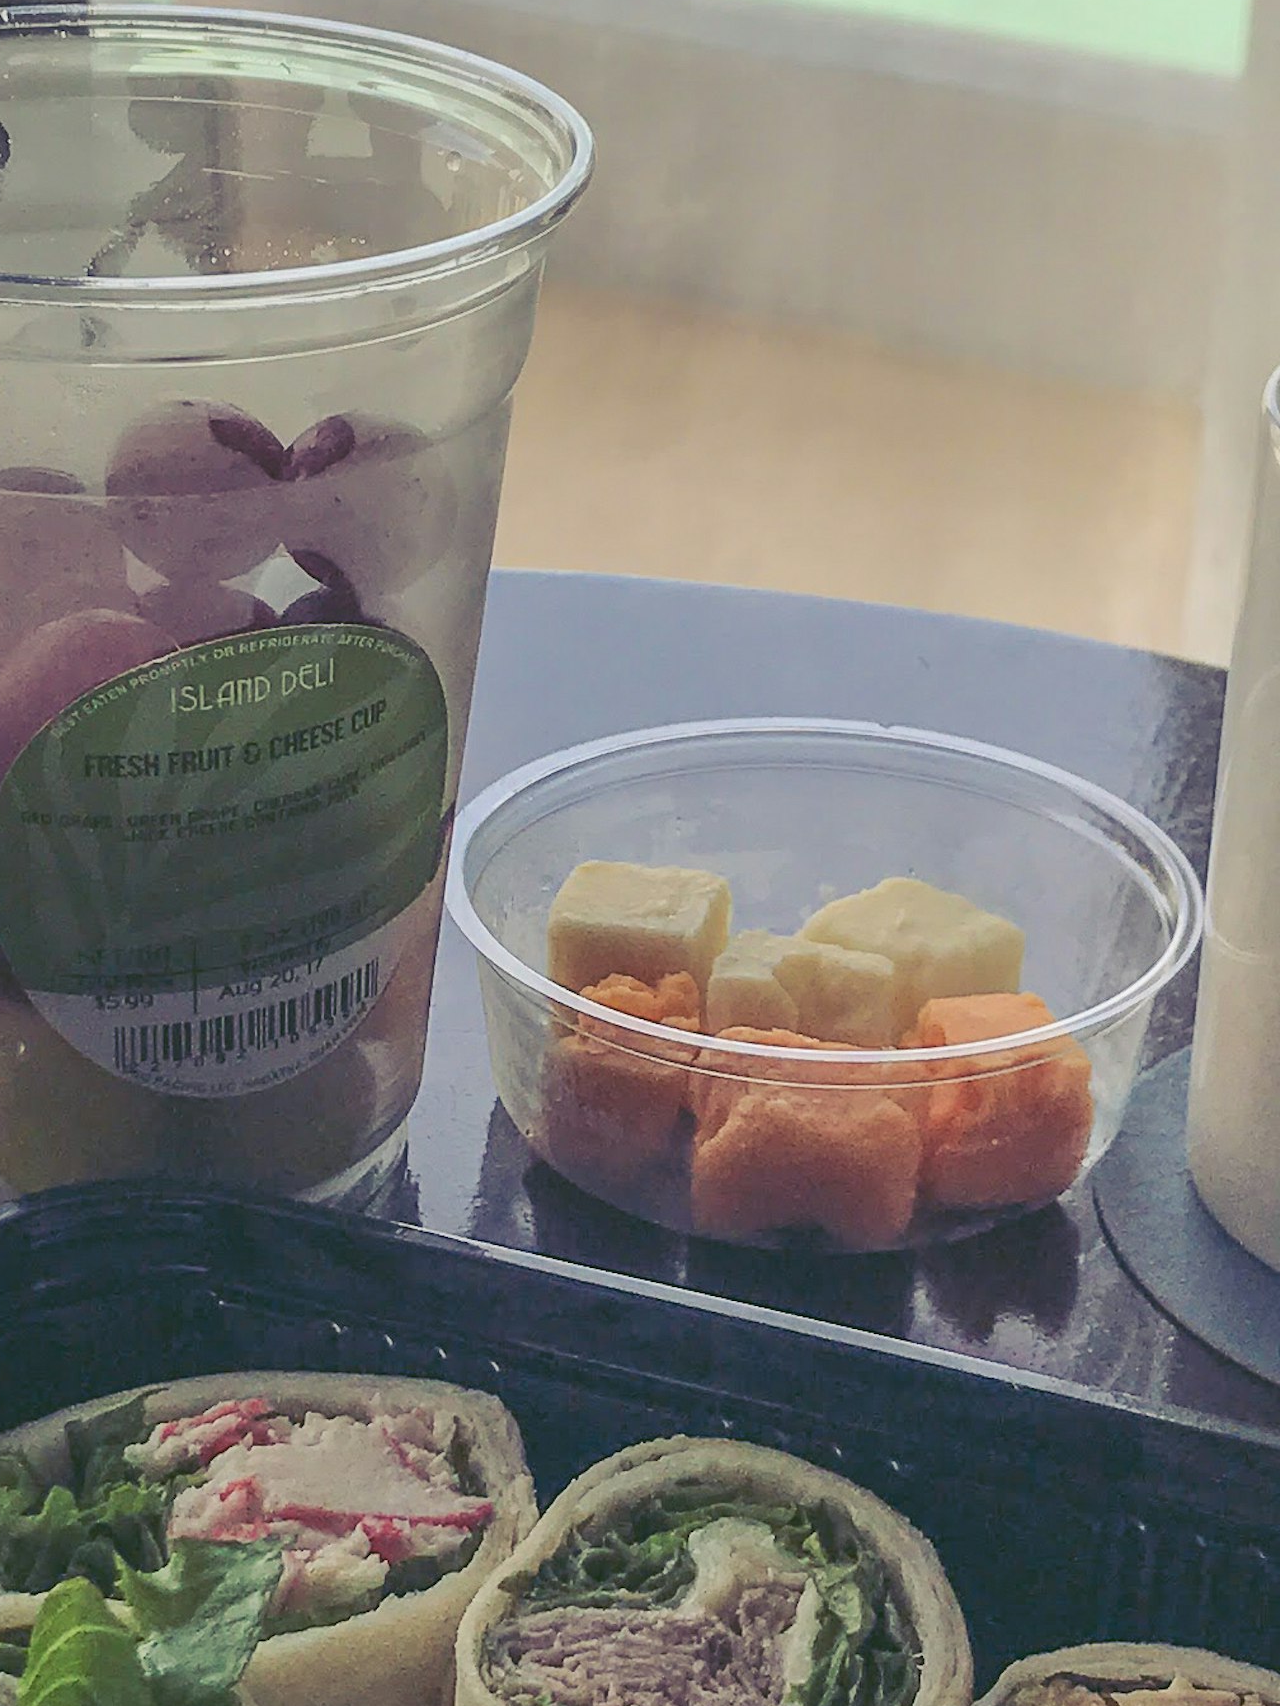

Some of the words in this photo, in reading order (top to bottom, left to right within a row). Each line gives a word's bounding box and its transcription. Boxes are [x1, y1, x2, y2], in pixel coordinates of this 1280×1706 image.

[82, 684, 128, 715] EATEN
[128, 652, 209, 690] PROMPTLY
[213, 645, 236, 661] OR
[239, 633, 335, 654] REFRIGERATE
[337, 633, 375, 650] AFTER
[169, 675, 272, 713] ISLAND
[280, 657, 335, 697] DELI
[84, 750, 160, 779] FRESH
[168, 743, 234, 775] FRUIT
[269, 717, 346, 761] CHEESE
[351, 697, 387, 735] CUP
[218, 979, 263, 1001] Aug
[270, 968, 299, 989] 20,
[307, 955, 324, 976] 17
